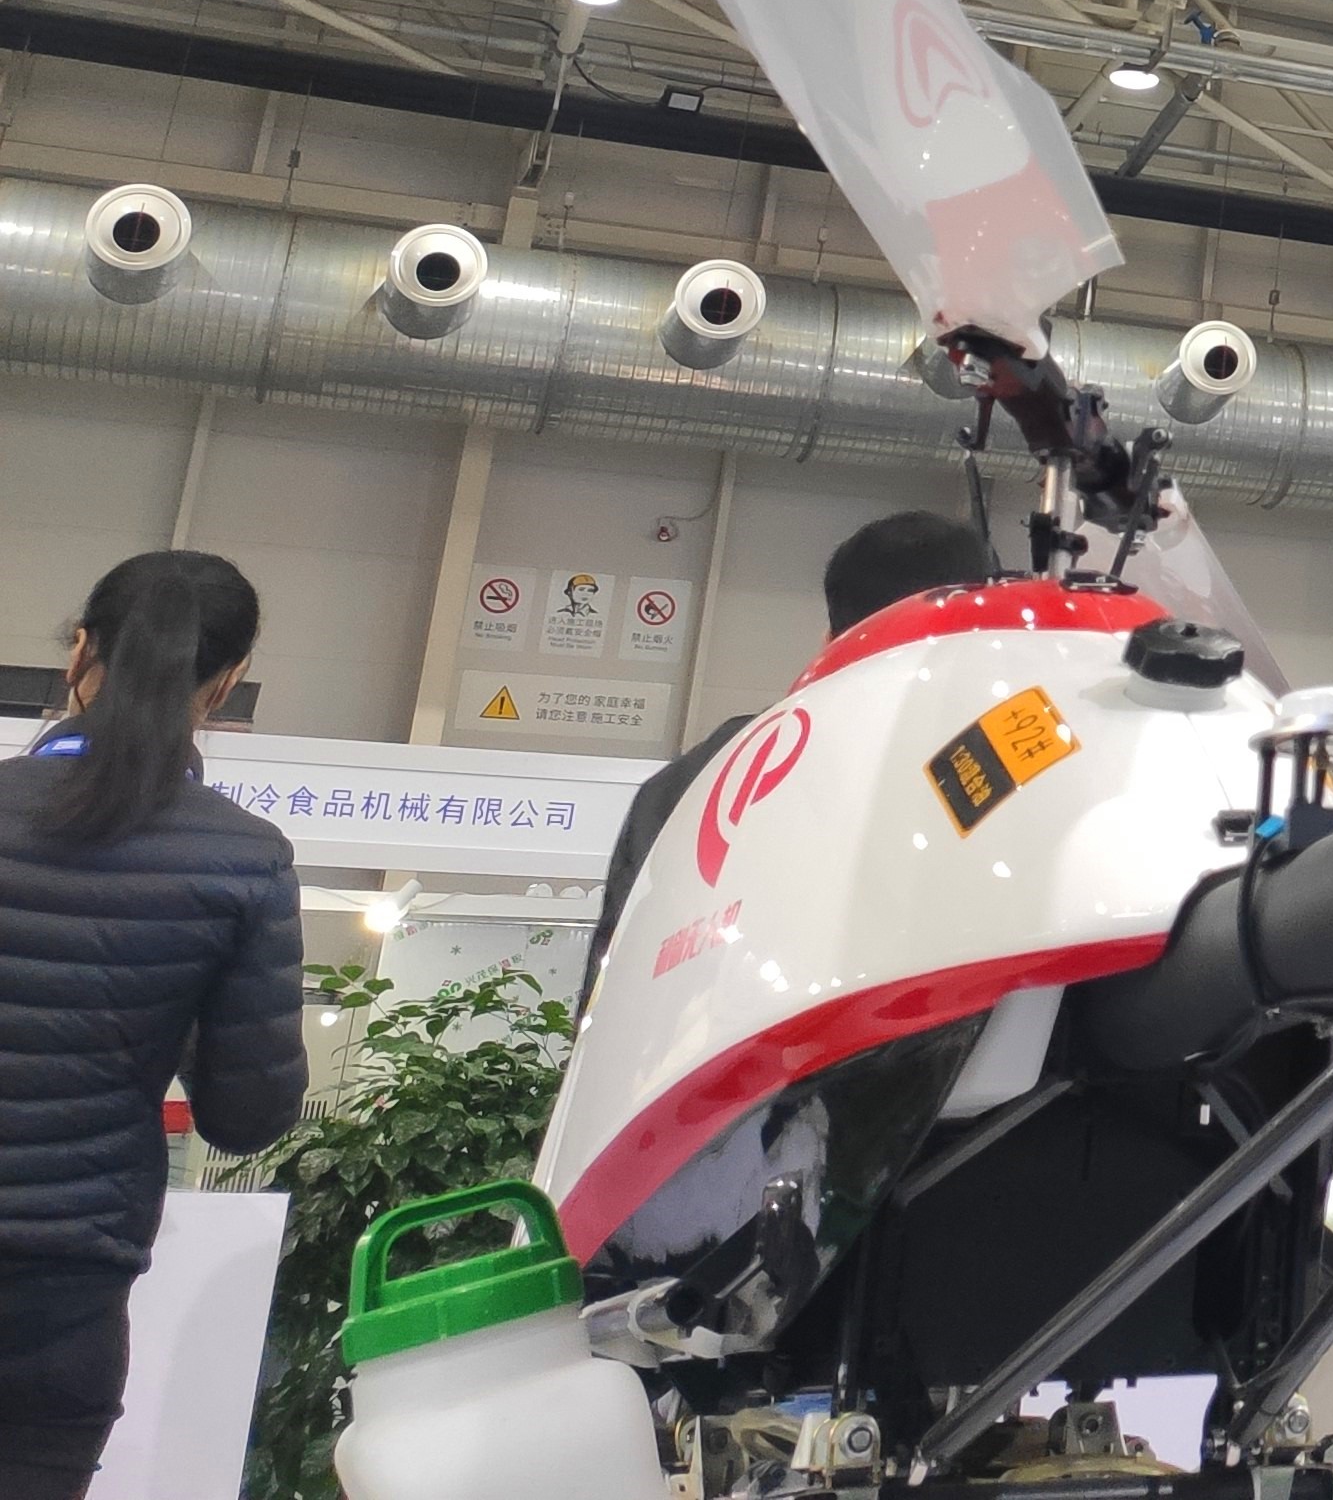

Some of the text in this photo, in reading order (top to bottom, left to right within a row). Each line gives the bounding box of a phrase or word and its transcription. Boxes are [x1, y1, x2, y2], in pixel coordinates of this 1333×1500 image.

[473, 620, 518, 633] 禁止吸烟
[630, 632, 674, 646] 禁止烟火
[537, 691, 591, 706] 为了您的
[209, 780, 577, 831] 制冷食品机械有限公司
